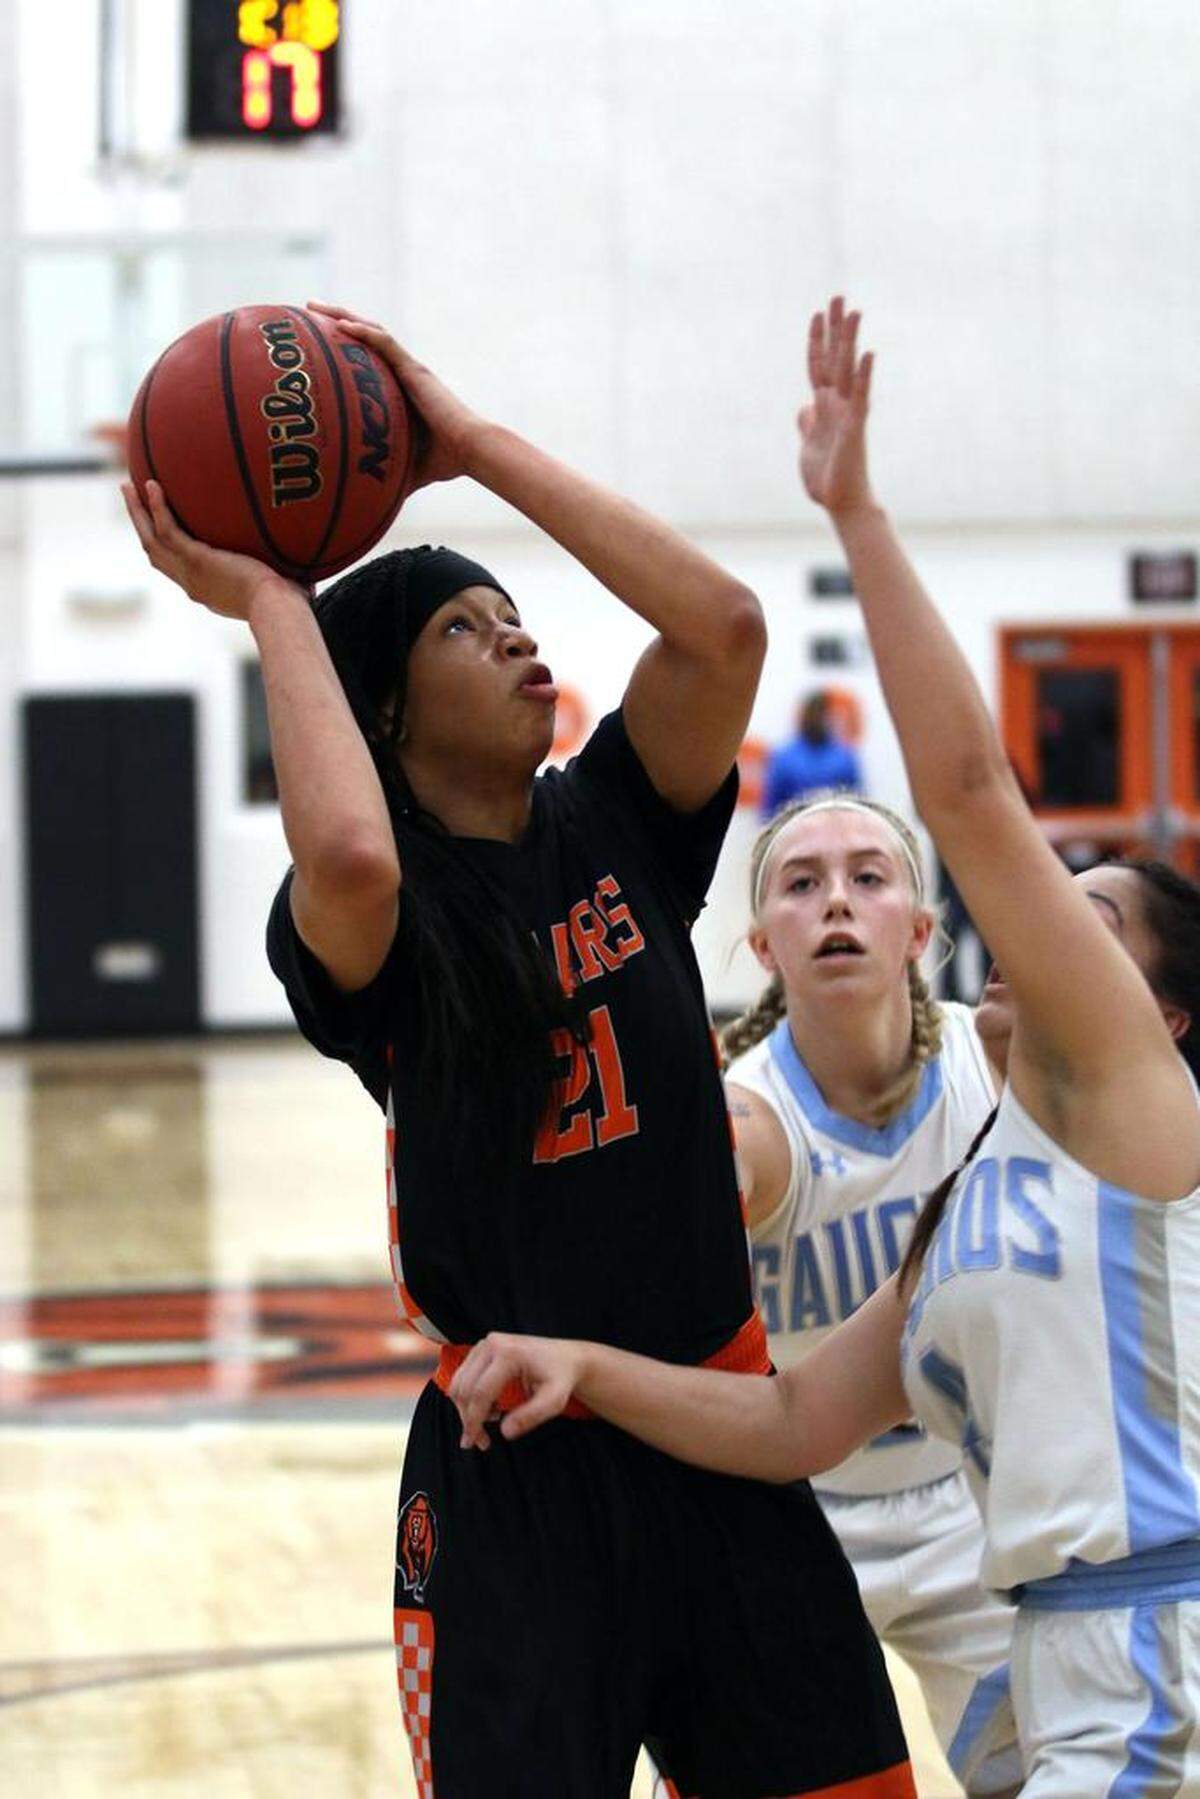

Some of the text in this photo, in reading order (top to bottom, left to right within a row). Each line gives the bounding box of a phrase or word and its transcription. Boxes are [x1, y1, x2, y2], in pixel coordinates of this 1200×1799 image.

[241, 41, 321, 130] 17
[259, 319, 324, 508] Wilson
[532, 1004, 640, 1164] 21
[751, 1195, 918, 1336] GAUC
